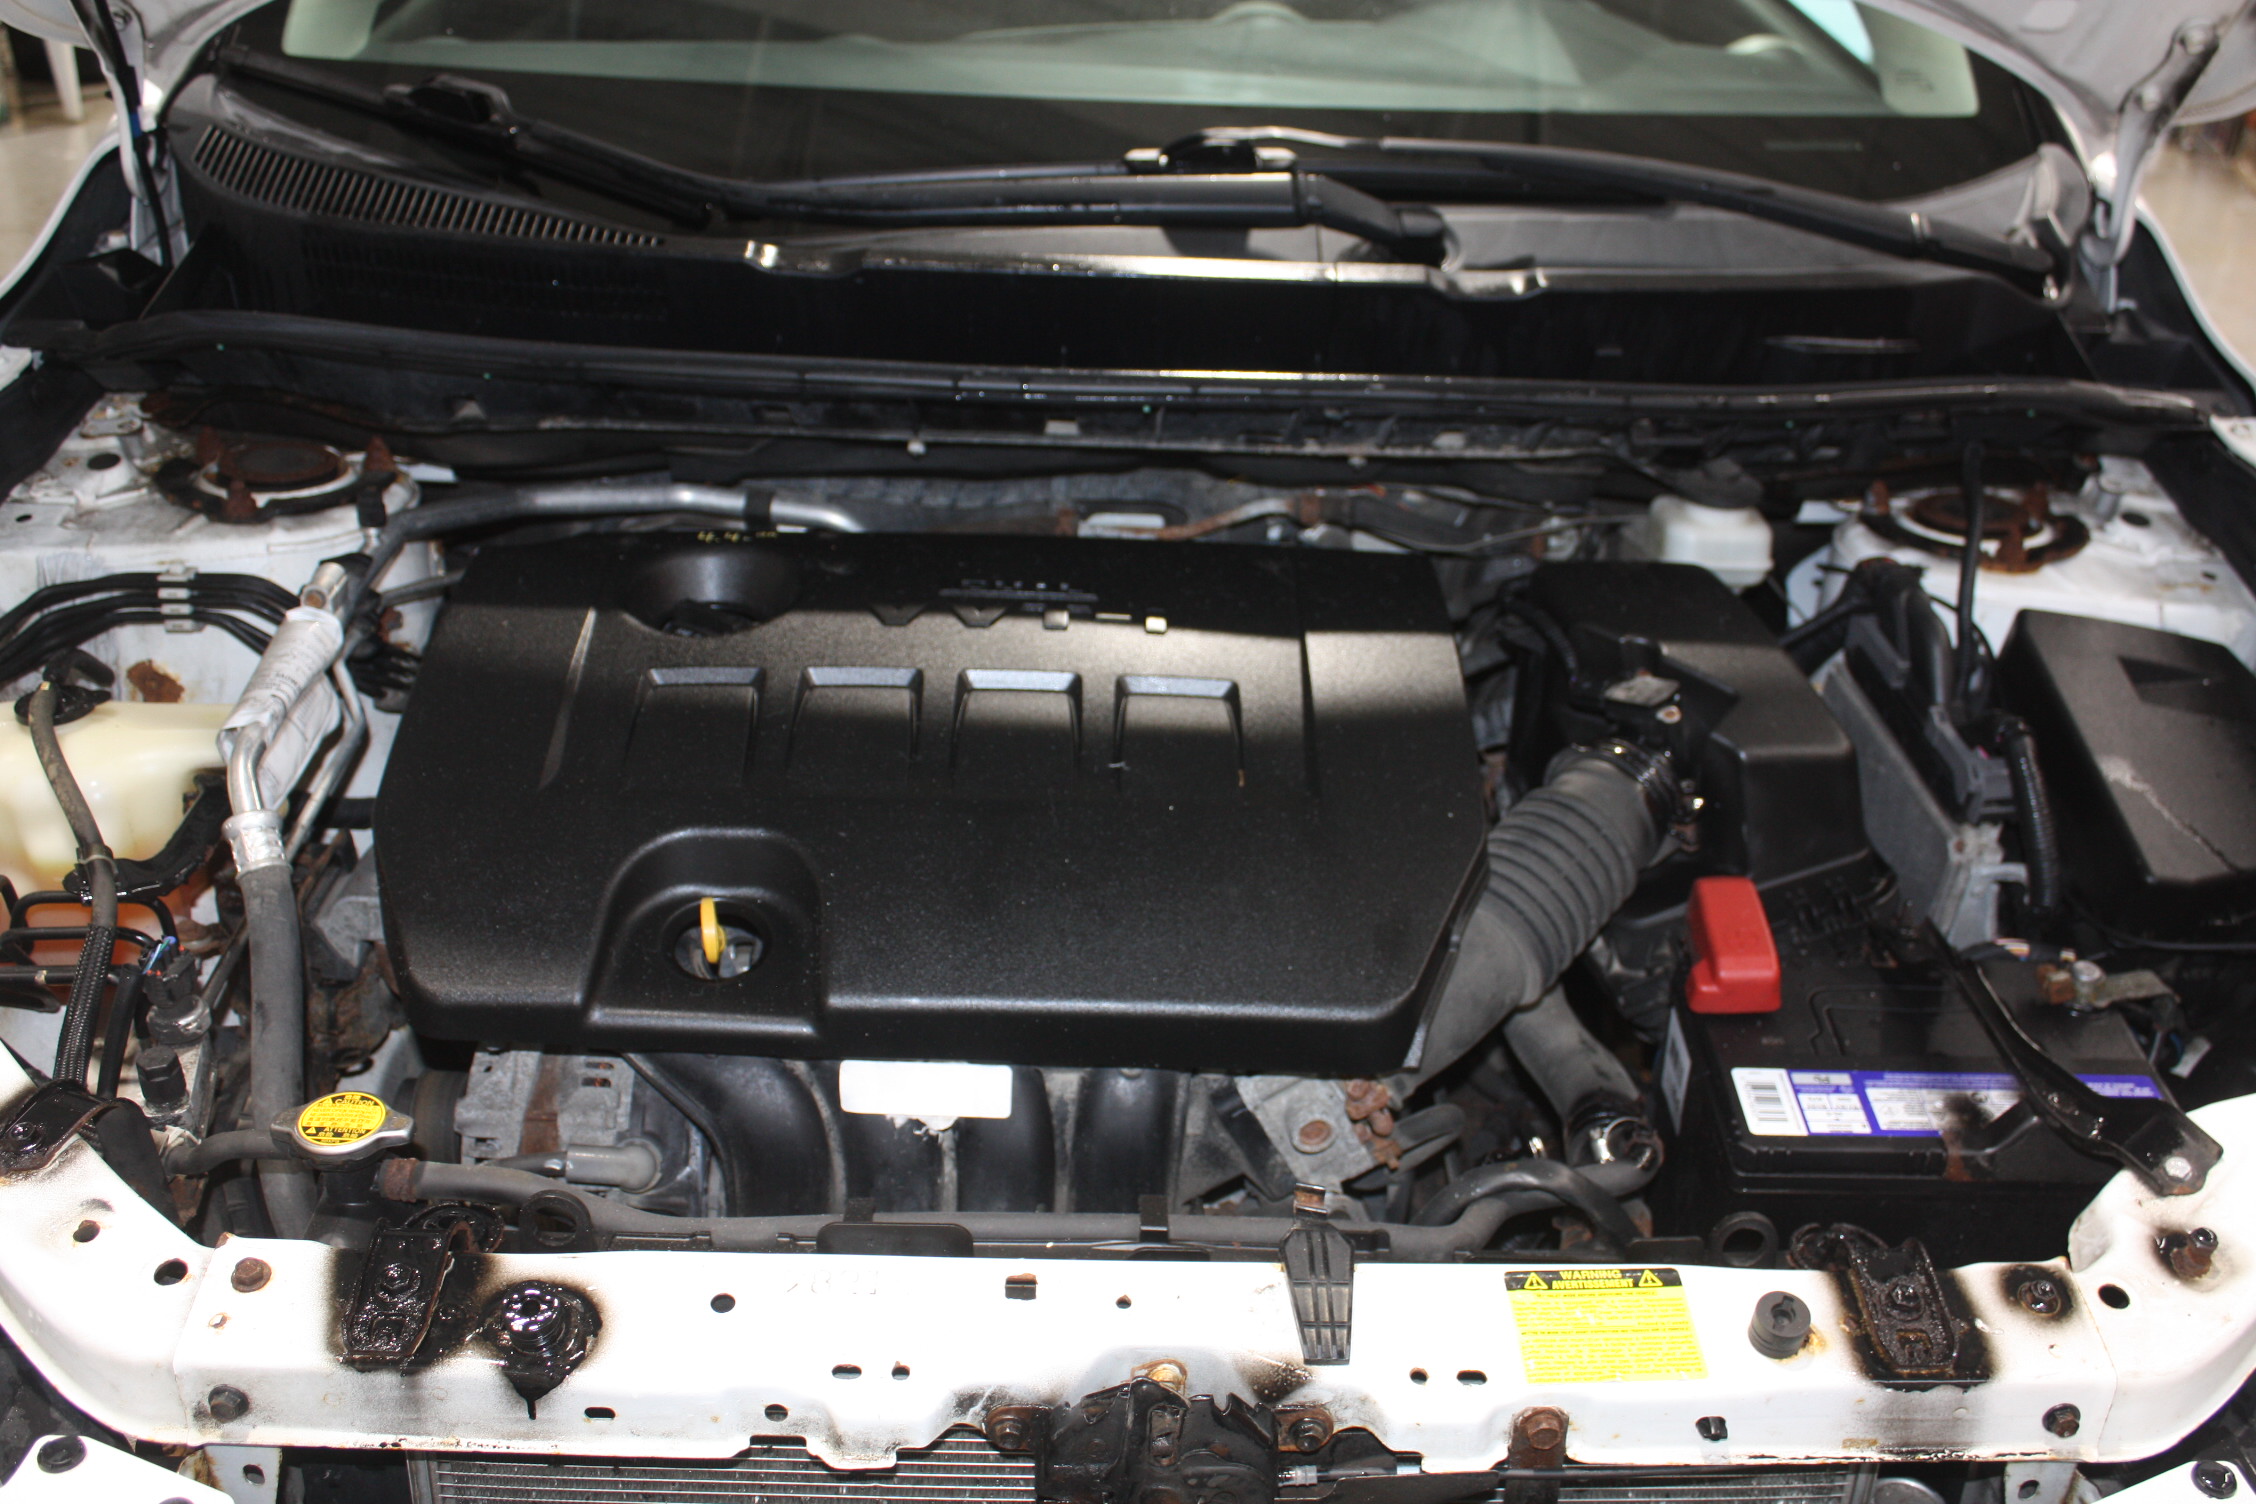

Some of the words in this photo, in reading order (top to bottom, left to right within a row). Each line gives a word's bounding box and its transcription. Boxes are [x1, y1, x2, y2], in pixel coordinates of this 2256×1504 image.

[335, 1098, 375, 1106] CAUTION
[1559, 1270, 1622, 1280] WARNING
[1551, 1278, 1635, 1290] AVERTISSEMENT
